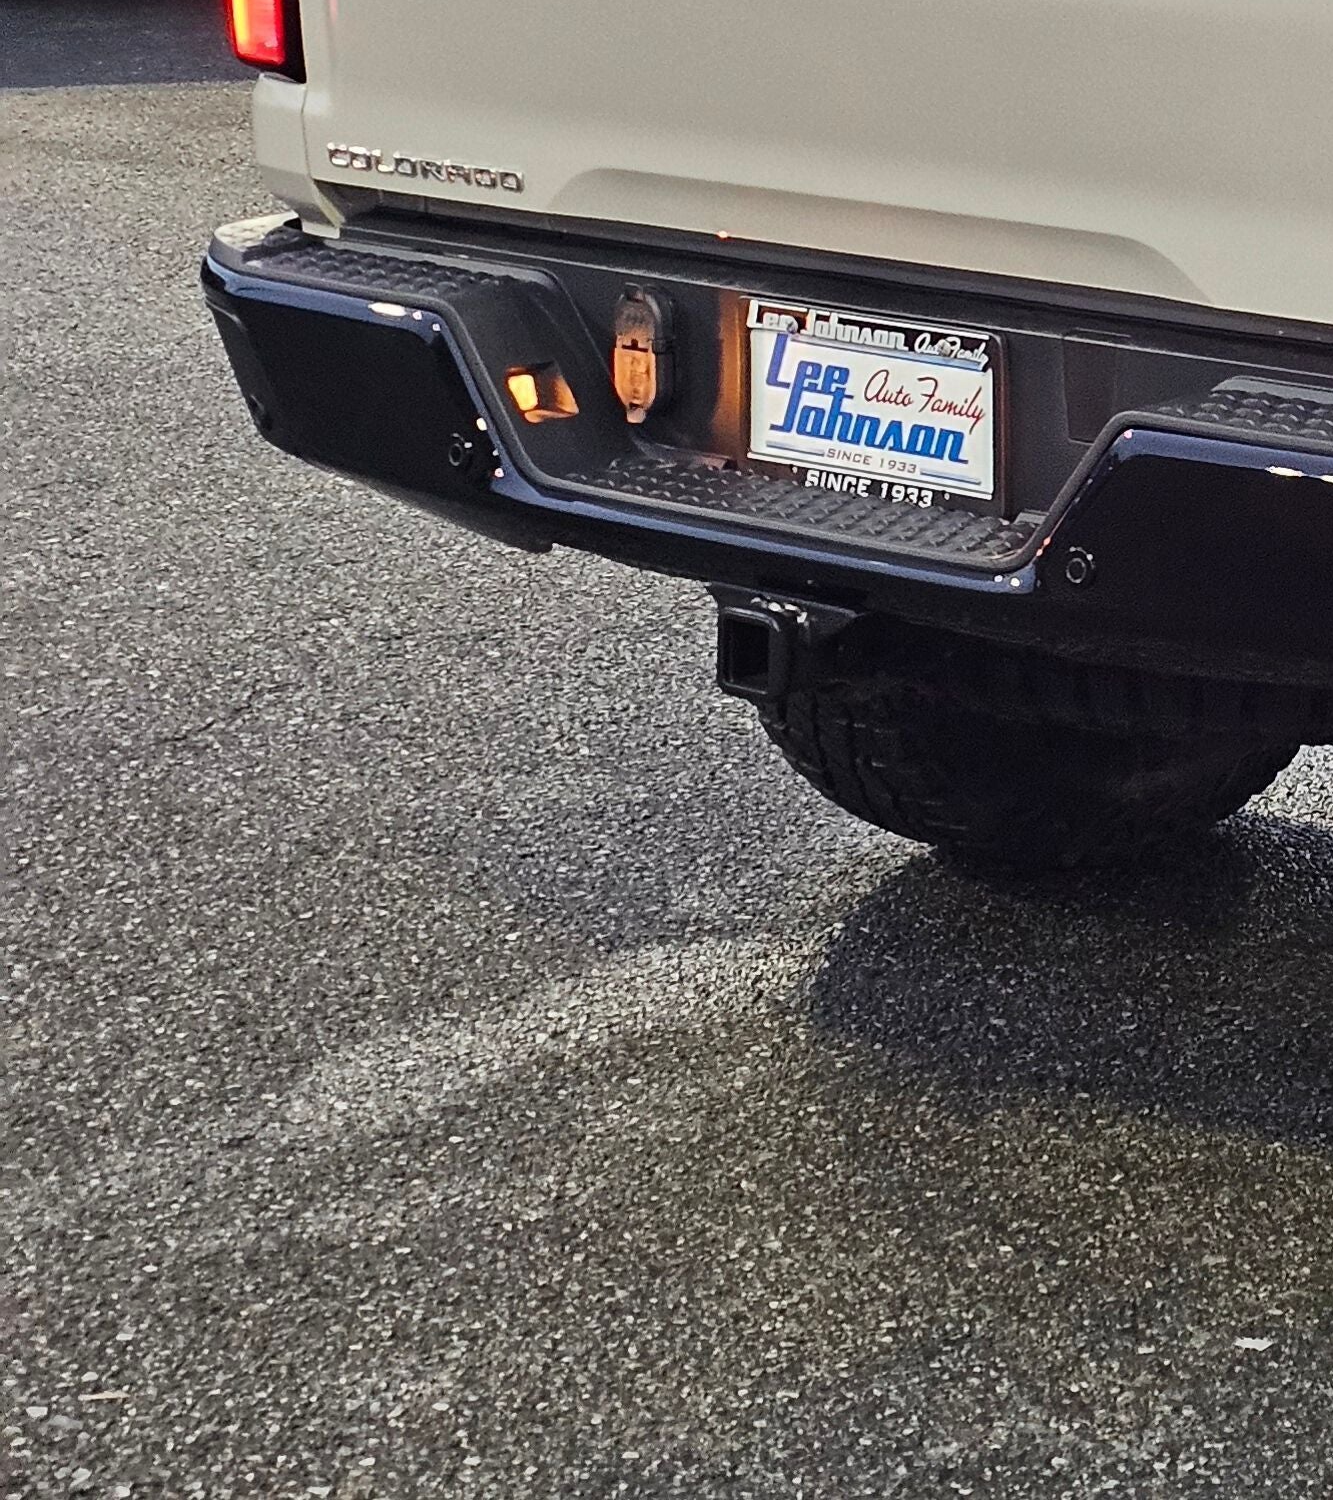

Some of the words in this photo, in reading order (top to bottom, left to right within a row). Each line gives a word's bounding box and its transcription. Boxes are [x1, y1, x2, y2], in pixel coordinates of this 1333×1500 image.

[326, 141, 526, 194] COLORADO
[747, 300, 799, 333] Lee
[799, 309, 909, 352] Johnson
[766, 333, 850, 396] Lee
[864, 368, 914, 408] Auto
[917, 376, 986, 435] Family
[769, 387, 969, 466] Johnson
[826, 448, 872, 466] SINCE
[879, 457, 917, 475] 1933
[804, 470, 872, 498] SINCE
[880, 482, 934, 510] 1933
